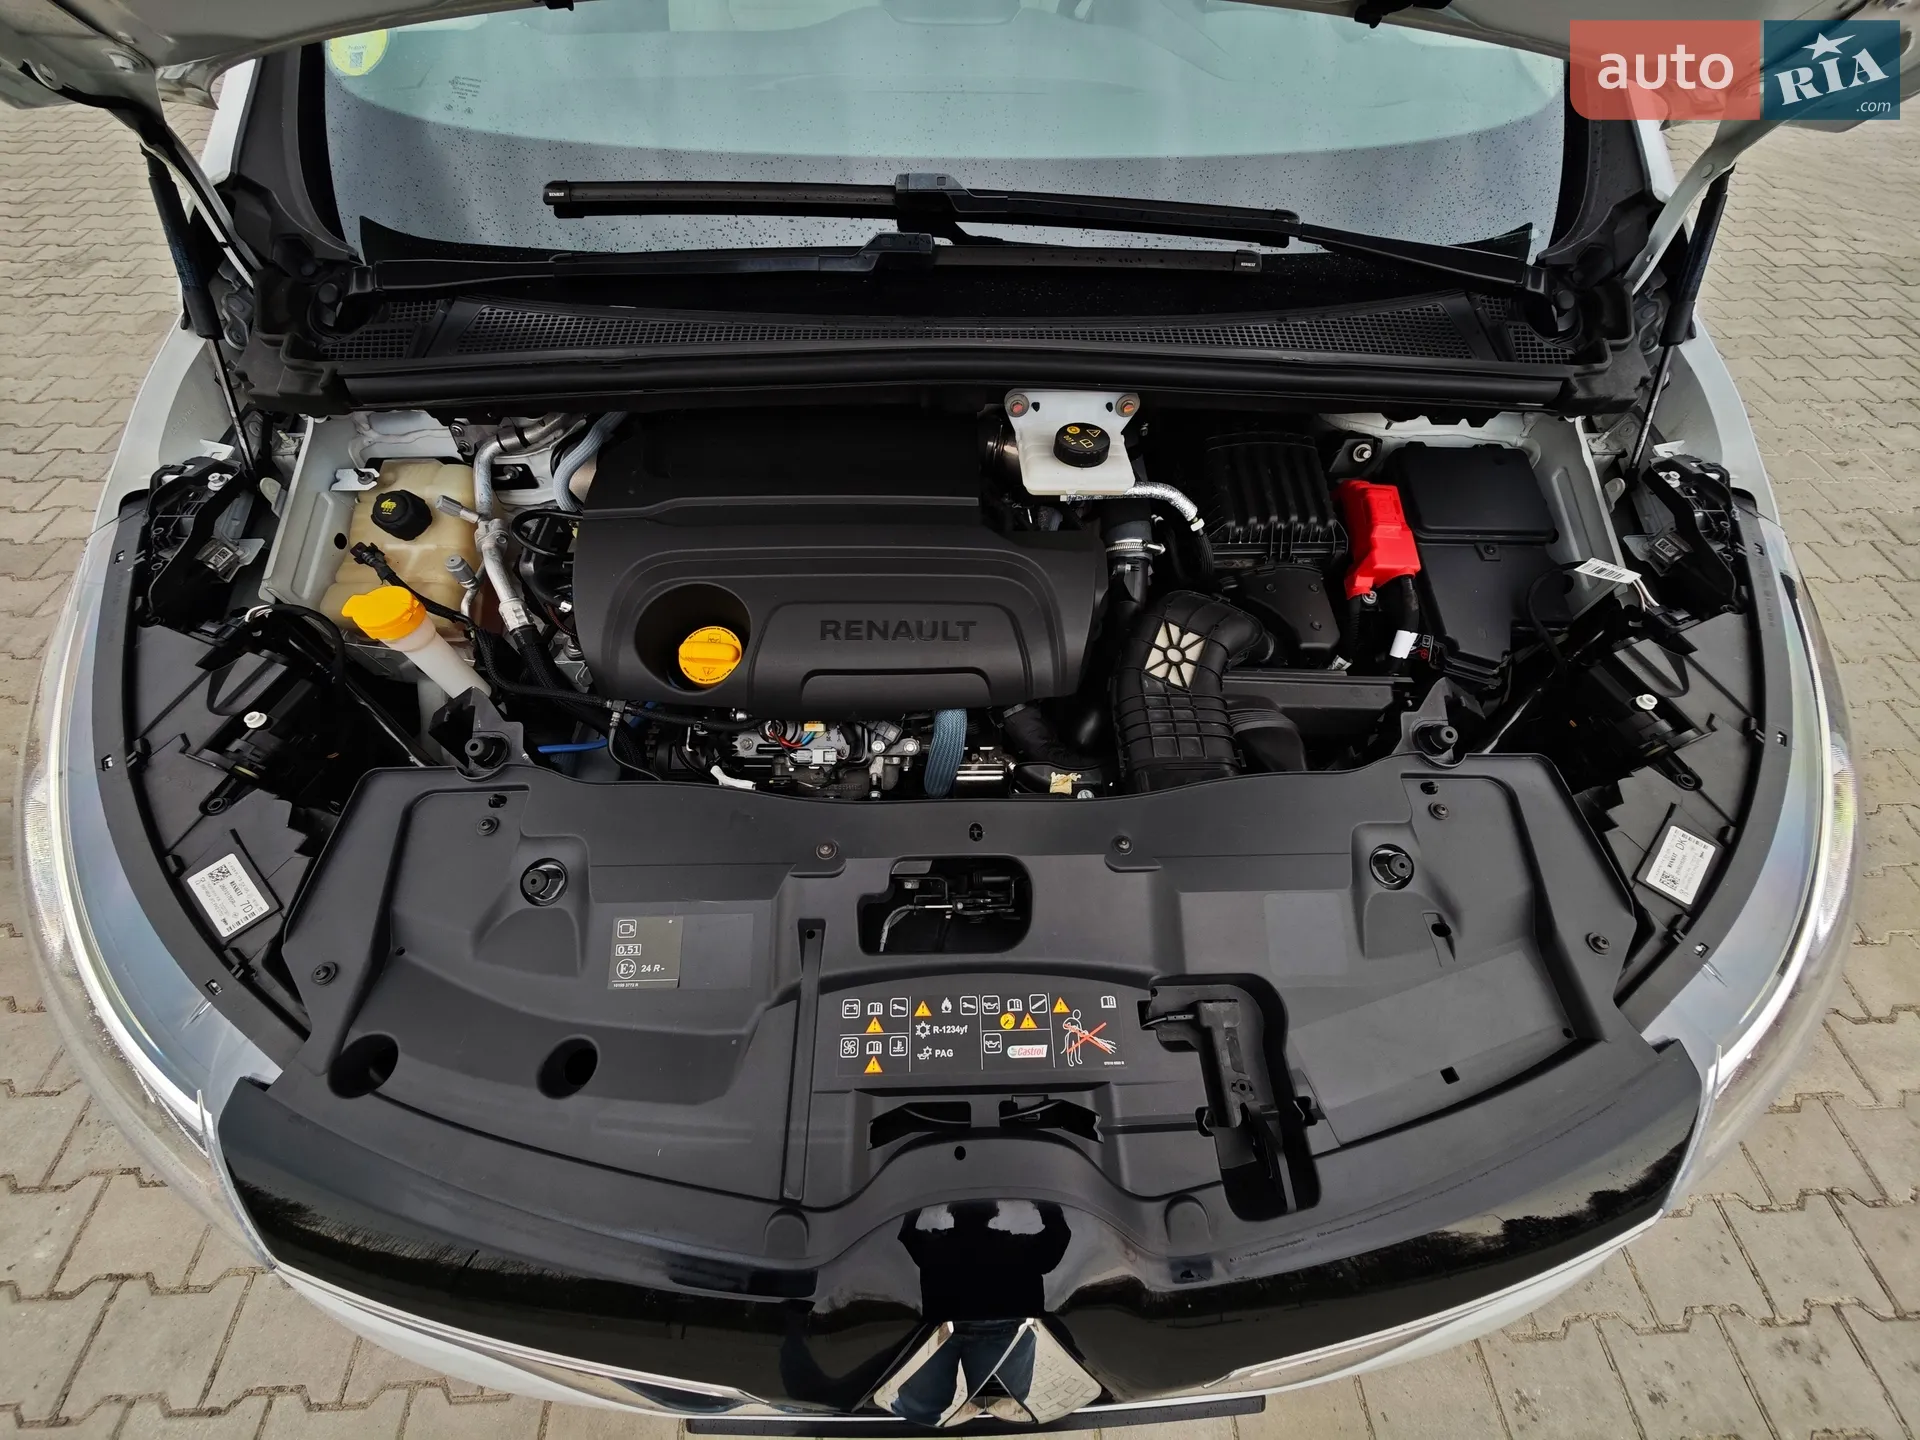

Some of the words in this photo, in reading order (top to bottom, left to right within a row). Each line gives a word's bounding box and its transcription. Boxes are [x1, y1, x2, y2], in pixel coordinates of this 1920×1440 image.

[820, 620, 978, 642] RENAULT
[239, 899, 254, 914] 7D
[617, 945, 640, 955] 0,51
[640, 964, 652, 973] 24
[932, 1024, 968, 1035] R-1234yf
[935, 1049, 954, 1058] PAG
[1017, 1045, 1045, 1057] Castrol
